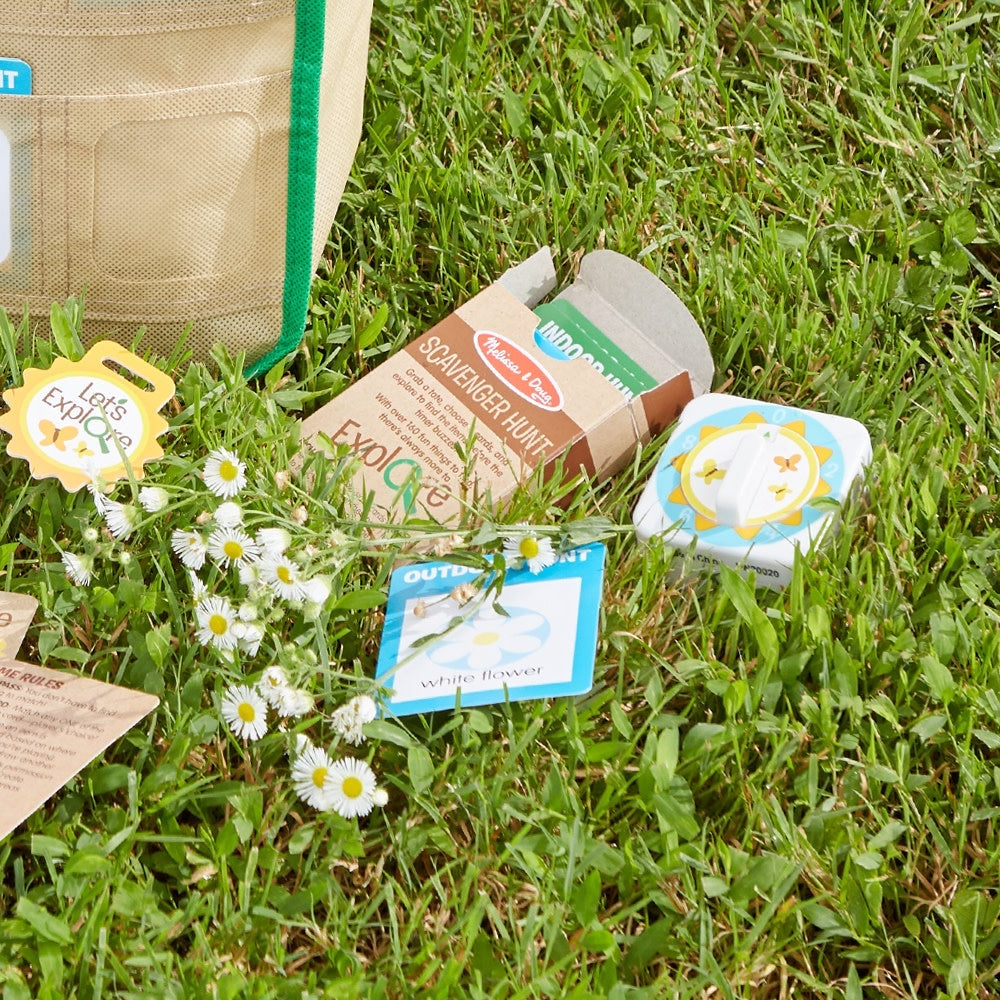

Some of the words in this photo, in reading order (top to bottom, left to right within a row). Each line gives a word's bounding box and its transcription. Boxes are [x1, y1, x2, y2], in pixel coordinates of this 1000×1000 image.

[482, 336, 521, 374] Melissa
[375, 392, 392, 410] With
[390, 408, 407, 423] over
[406, 420, 421, 435] 160
[418, 432, 431, 447] fun
[430, 444, 452, 466] things
[450, 463, 459, 474] to
[392, 373, 418, 397] explore
[416, 394, 426, 404] to
[424, 401, 441, 416] find
[438, 414, 451, 427] the
[489, 462, 504, 477] the
[406, 368, 424, 386] Grab
[443, 404, 469, 427] choose
[494, 450, 510, 467] and
[415, 409, 434, 427] timer
[432, 424, 455, 450] buzze
[419, 336, 511, 418] SCAVENGER
[501, 409, 555, 457] HUNT
[331, 418, 453, 508] Exploe
[378, 413, 401, 436] there's
[400, 434, 425, 458] always
[424, 456, 443, 474] more
[441, 472, 451, 482] to
[20, 673, 64, 689] RULES
[421, 673, 475, 689] white
[482, 666, 545, 682] flower
